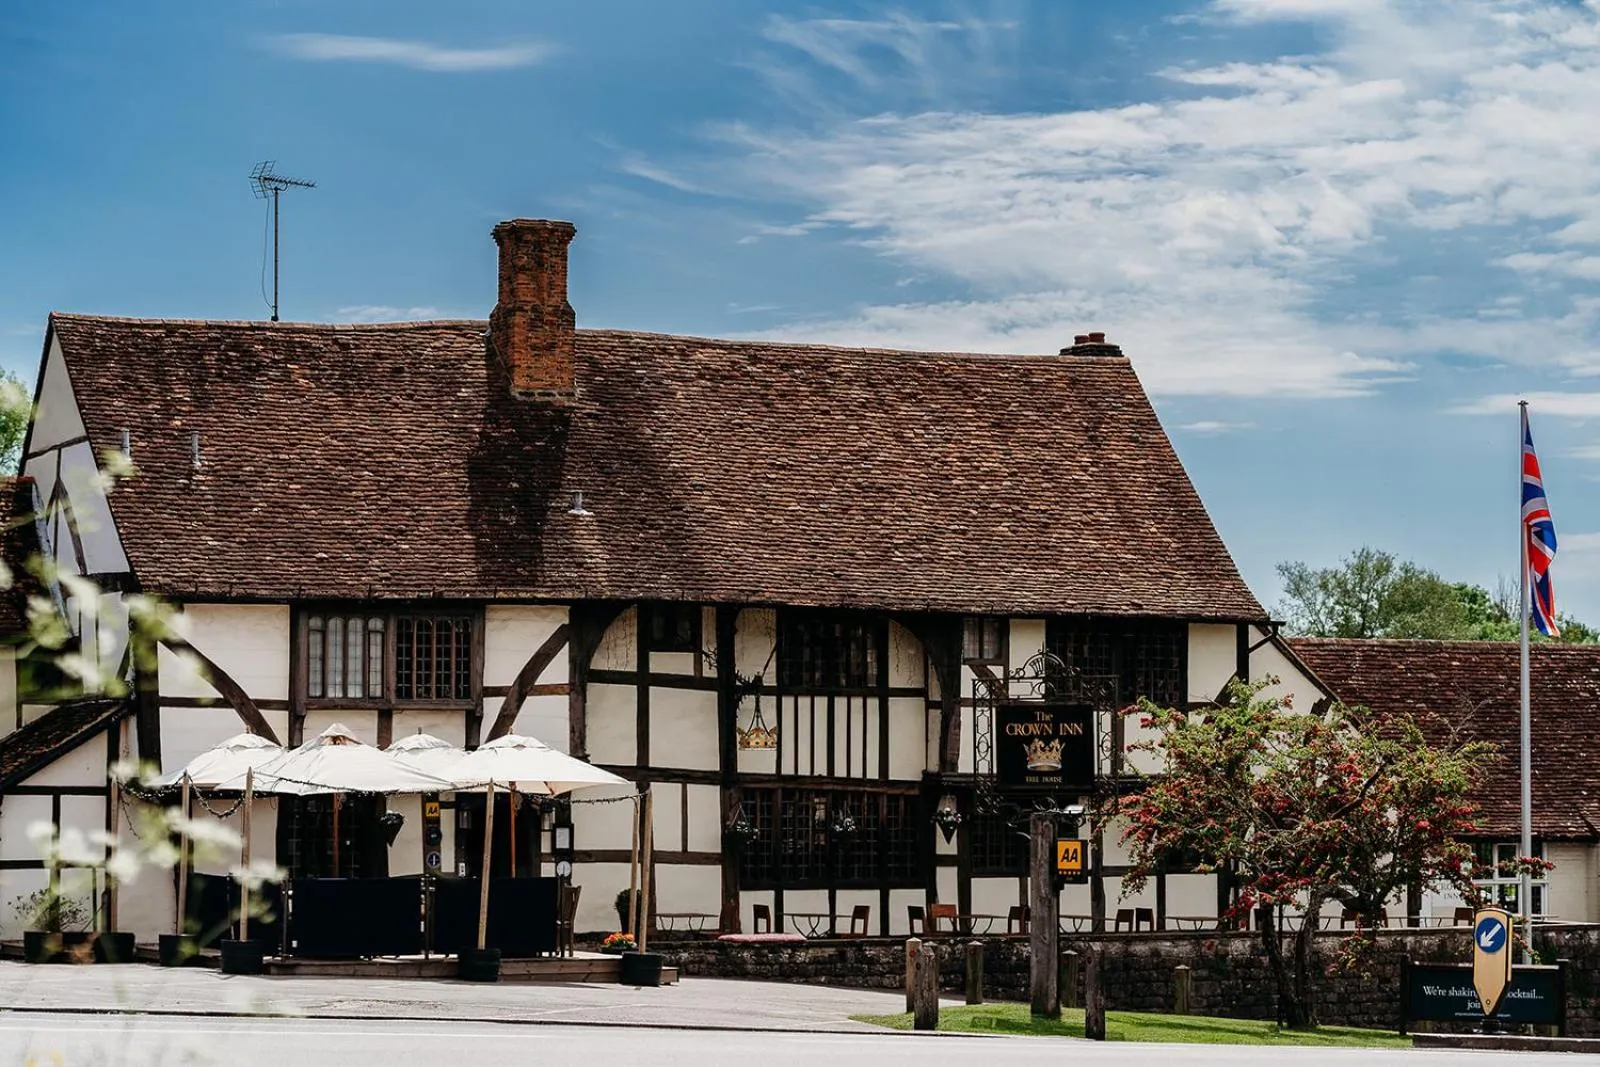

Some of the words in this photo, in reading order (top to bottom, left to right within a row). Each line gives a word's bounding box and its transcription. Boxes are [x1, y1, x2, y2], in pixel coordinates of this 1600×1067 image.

[1034, 711, 1054, 721] The
[1006, 723, 1053, 736] CROWN
[1060, 723, 1083, 736] INN
[1060, 848, 1078, 862] AA
[1423, 985, 1447, 996] We're
[1505, 988, 1544, 999] ocktail...
